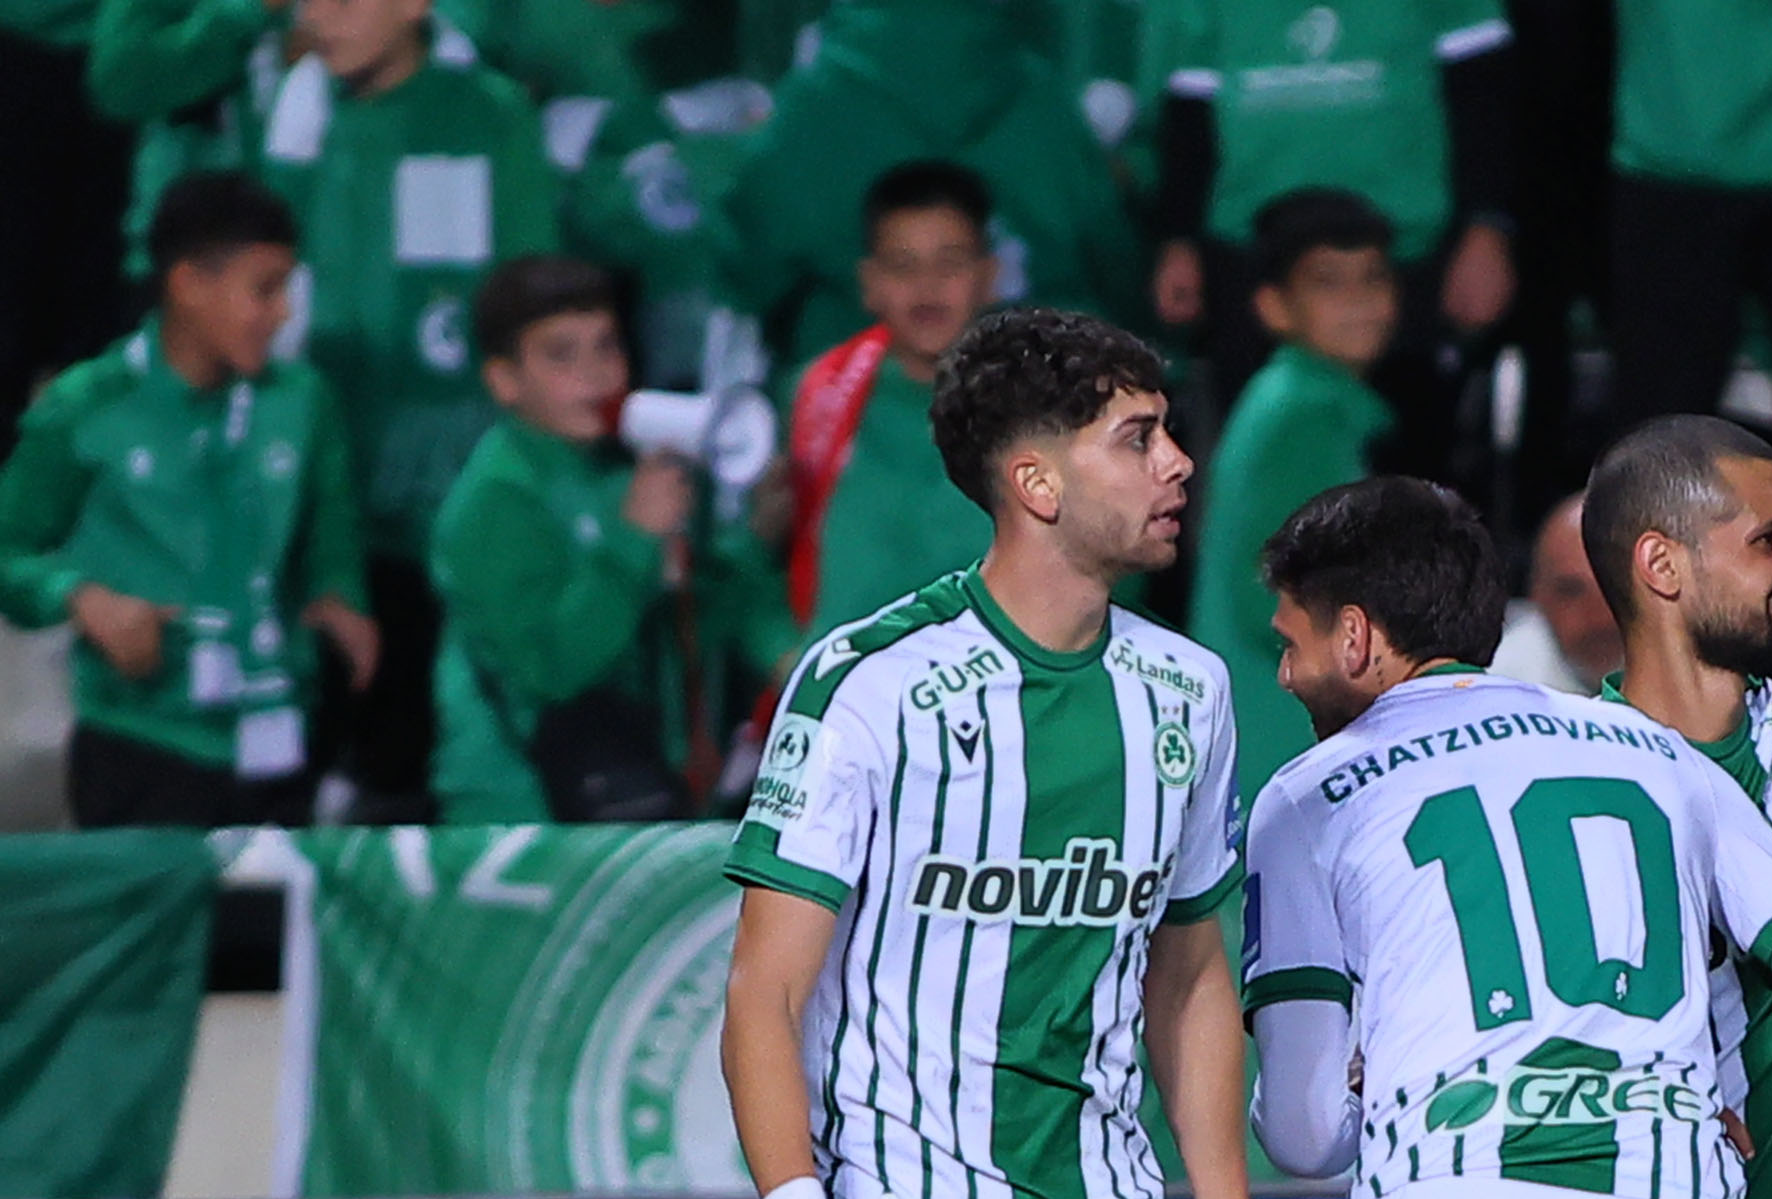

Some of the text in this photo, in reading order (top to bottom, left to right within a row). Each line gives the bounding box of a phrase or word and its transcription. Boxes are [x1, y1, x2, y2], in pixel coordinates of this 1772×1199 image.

[1136, 654, 1205, 700] Landas
[1403, 776, 1685, 1032] 10
[1507, 1074, 1700, 1122] GREE
